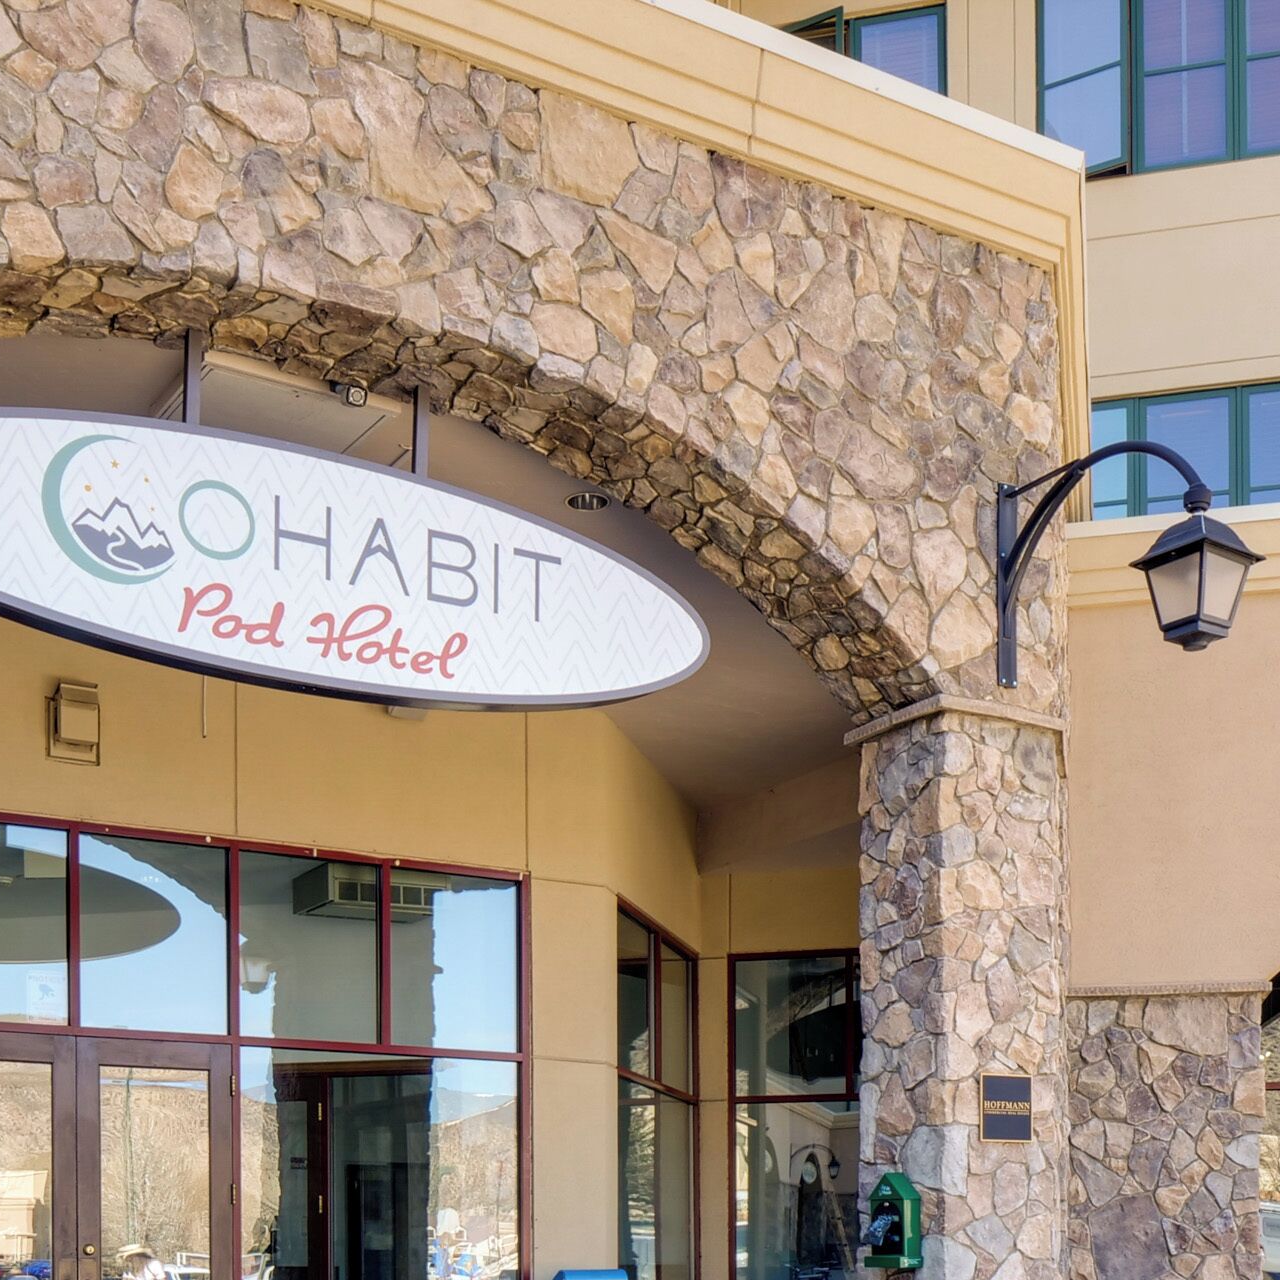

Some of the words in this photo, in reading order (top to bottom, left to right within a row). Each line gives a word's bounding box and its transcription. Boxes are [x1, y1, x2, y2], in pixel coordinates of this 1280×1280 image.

[177, 584, 284, 648] Pod
[306, 602, 468, 682] Hotel
[983, 1100, 1030, 1110] HOFFMANN
